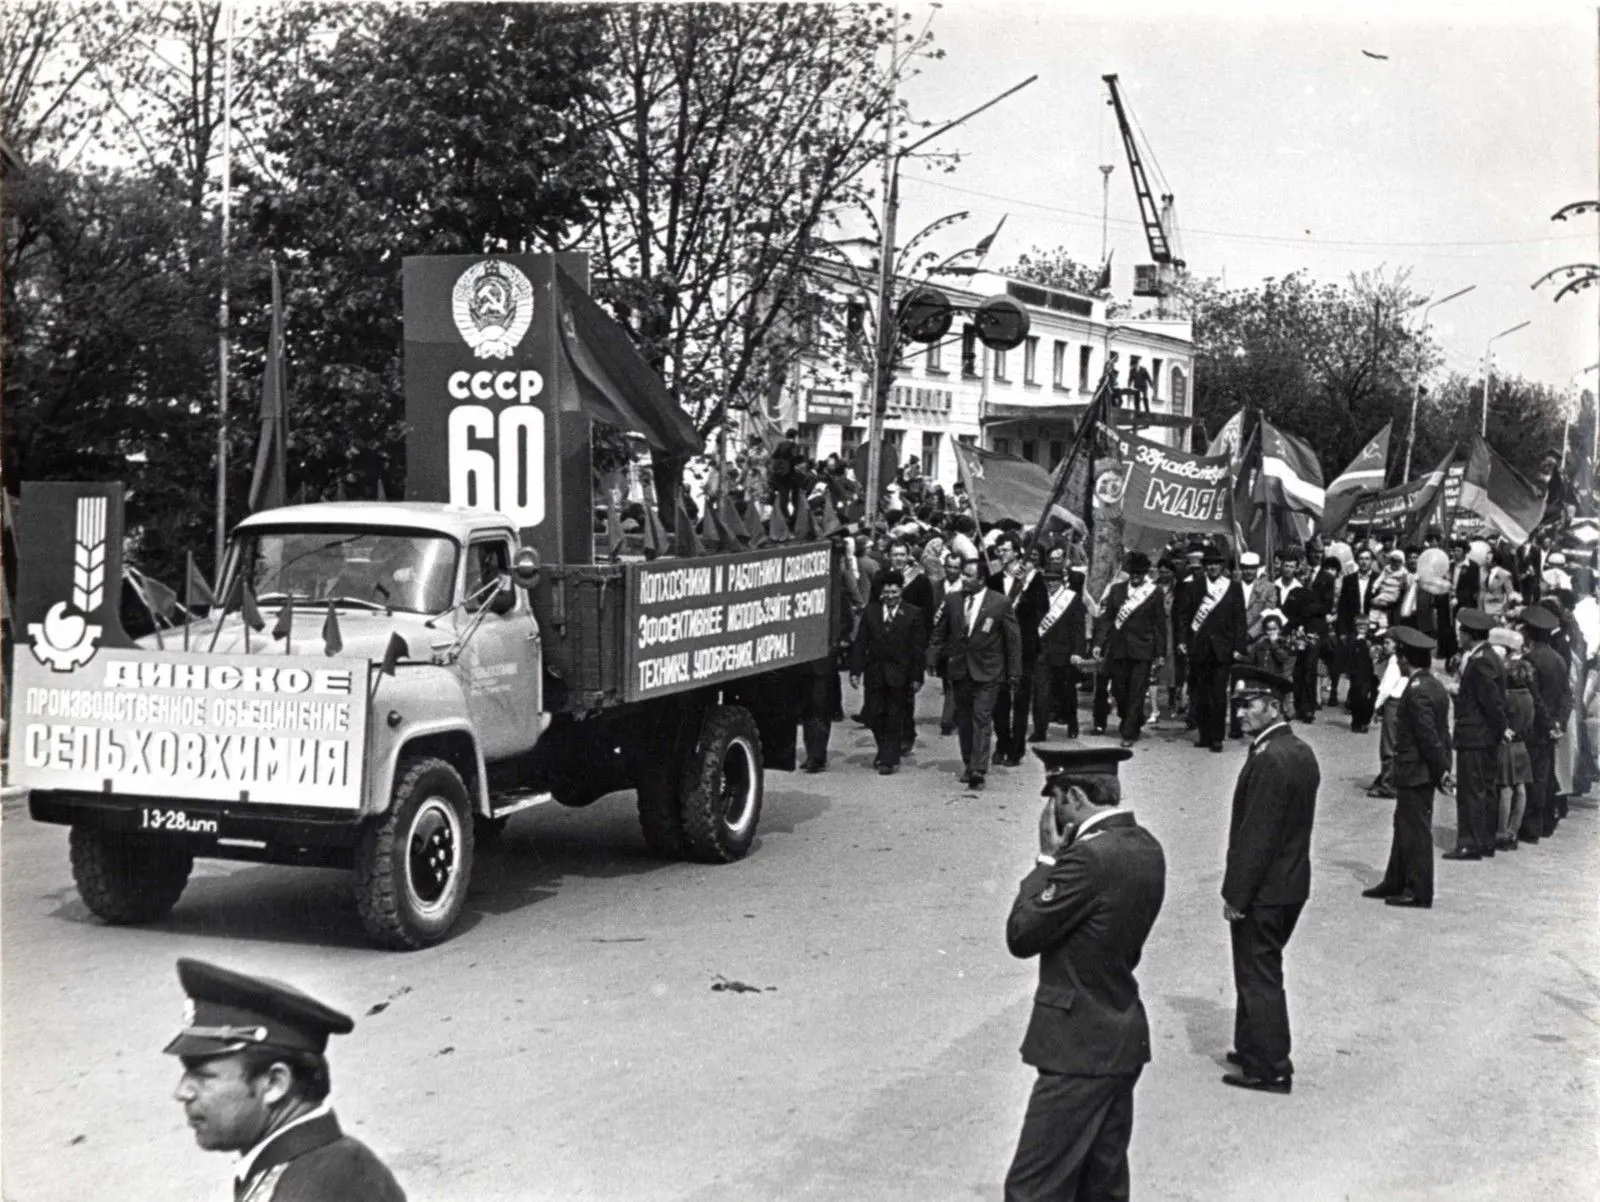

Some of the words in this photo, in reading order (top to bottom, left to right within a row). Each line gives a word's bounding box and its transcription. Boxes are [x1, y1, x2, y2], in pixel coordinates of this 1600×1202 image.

[448, 370, 544, 403] СССР
[448, 405, 545, 528] 60
[1144, 478, 1227, 520] МАЯ!
[715, 565, 724, 593] И
[103, 659, 353, 695] ДИНСКОЕ
[25, 686, 206, 727] ПРОИЗВОДСТВЕННОЕ
[212, 698, 350, 732] ОБЪЕДИНЕНИЕ
